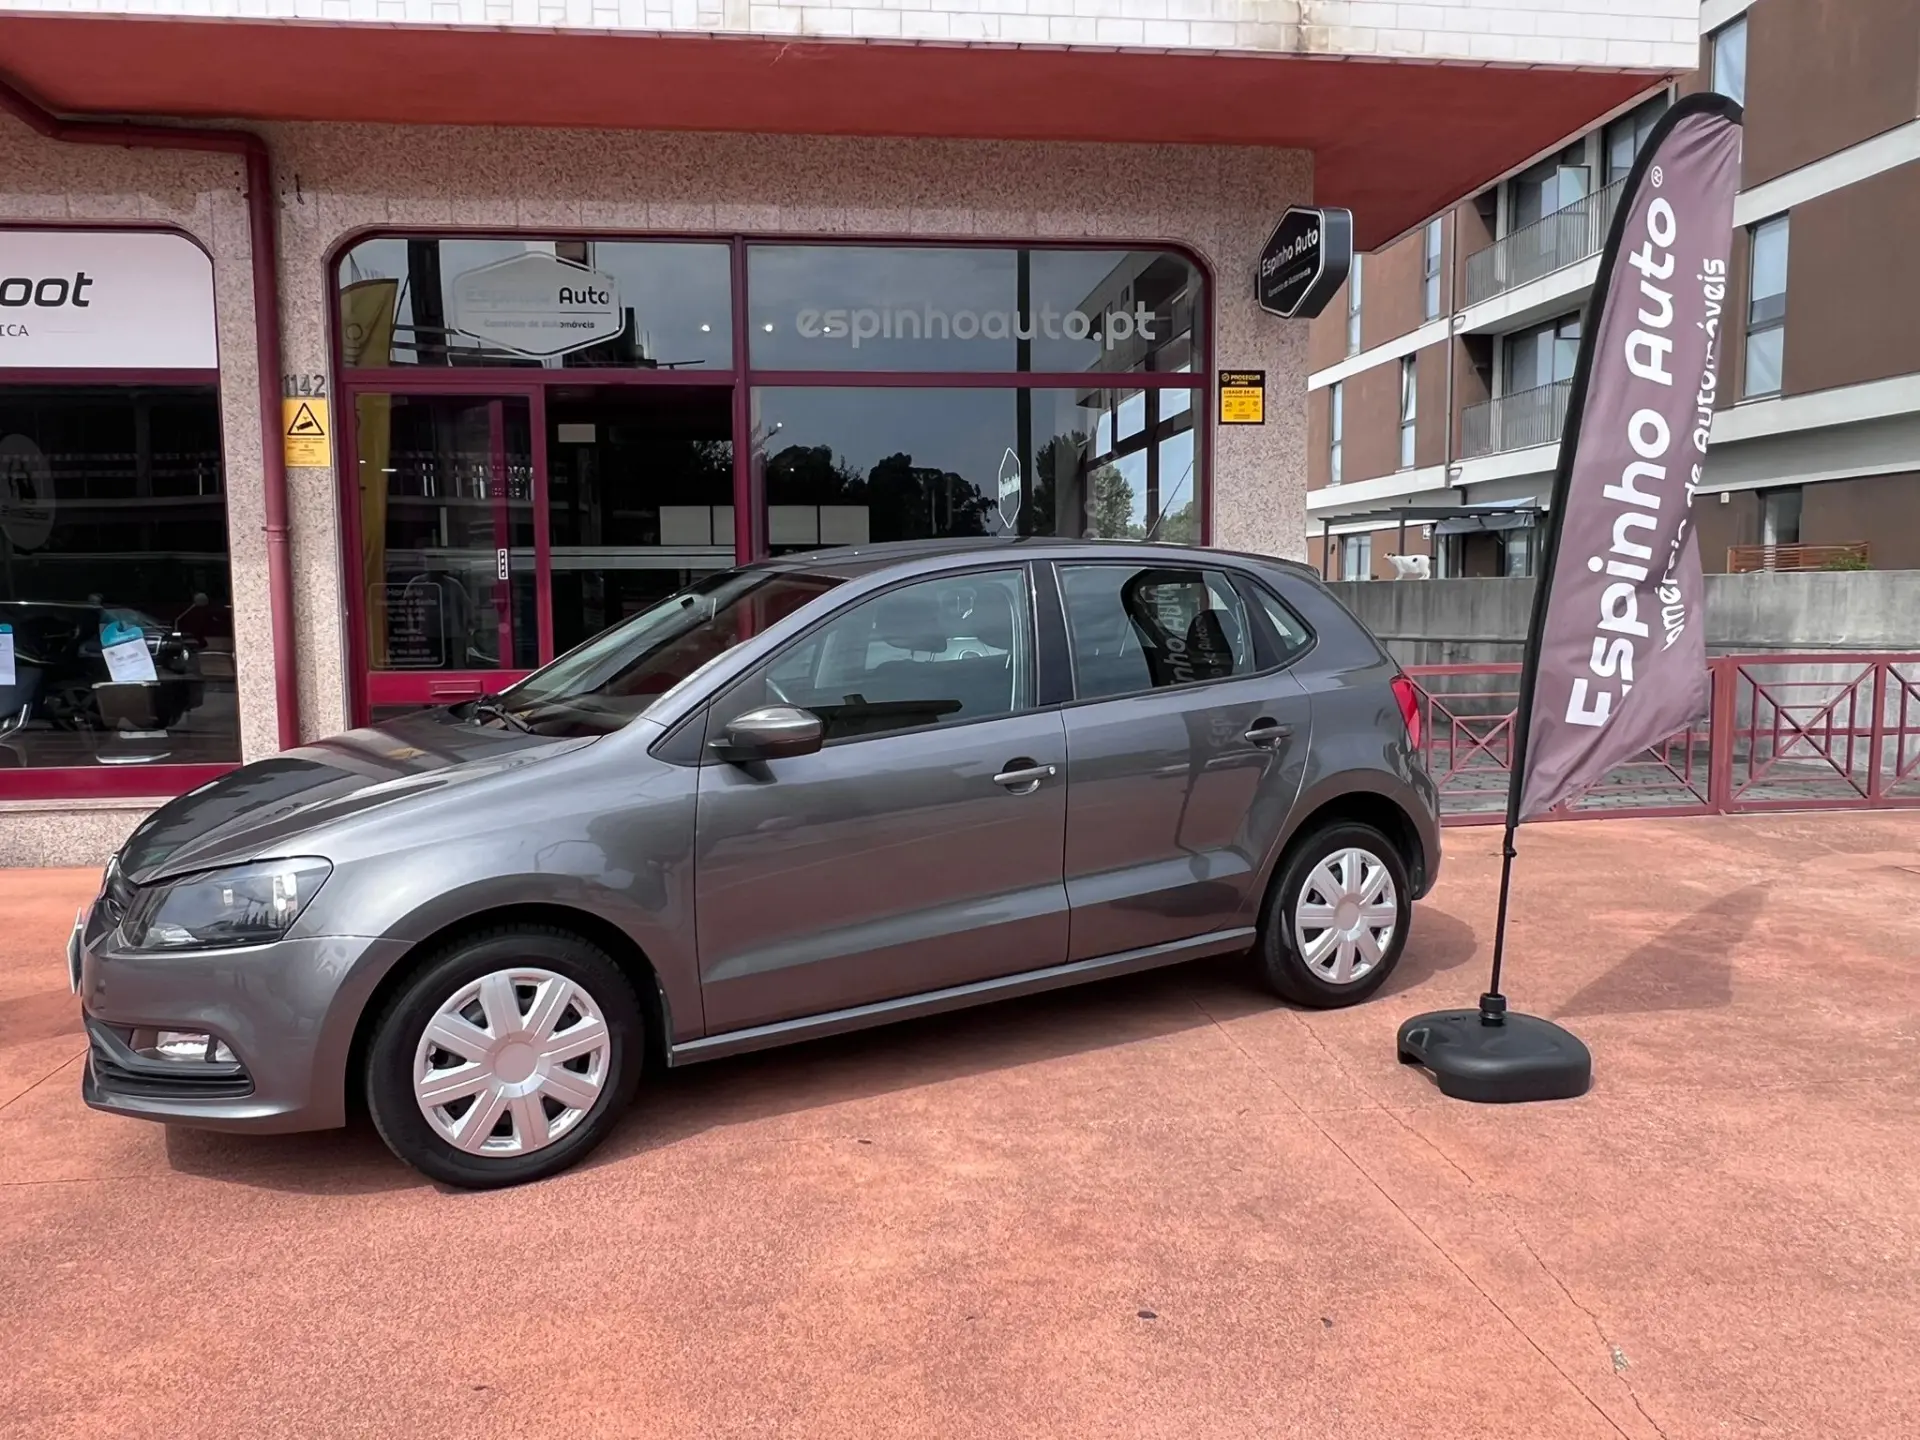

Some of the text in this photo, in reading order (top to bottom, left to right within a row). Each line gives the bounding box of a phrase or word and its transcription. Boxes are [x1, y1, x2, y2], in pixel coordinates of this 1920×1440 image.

[1262, 228, 1319, 278] Espinho Auto
[0, 272, 93, 307] oot
[559, 286, 610, 304] Auto
[796, 301, 1156, 350] espinhoauto.pt
[284, 374, 326, 398] 1142
[1565, 408, 1671, 727] Espinho
[1624, 197, 1677, 386] Auto
